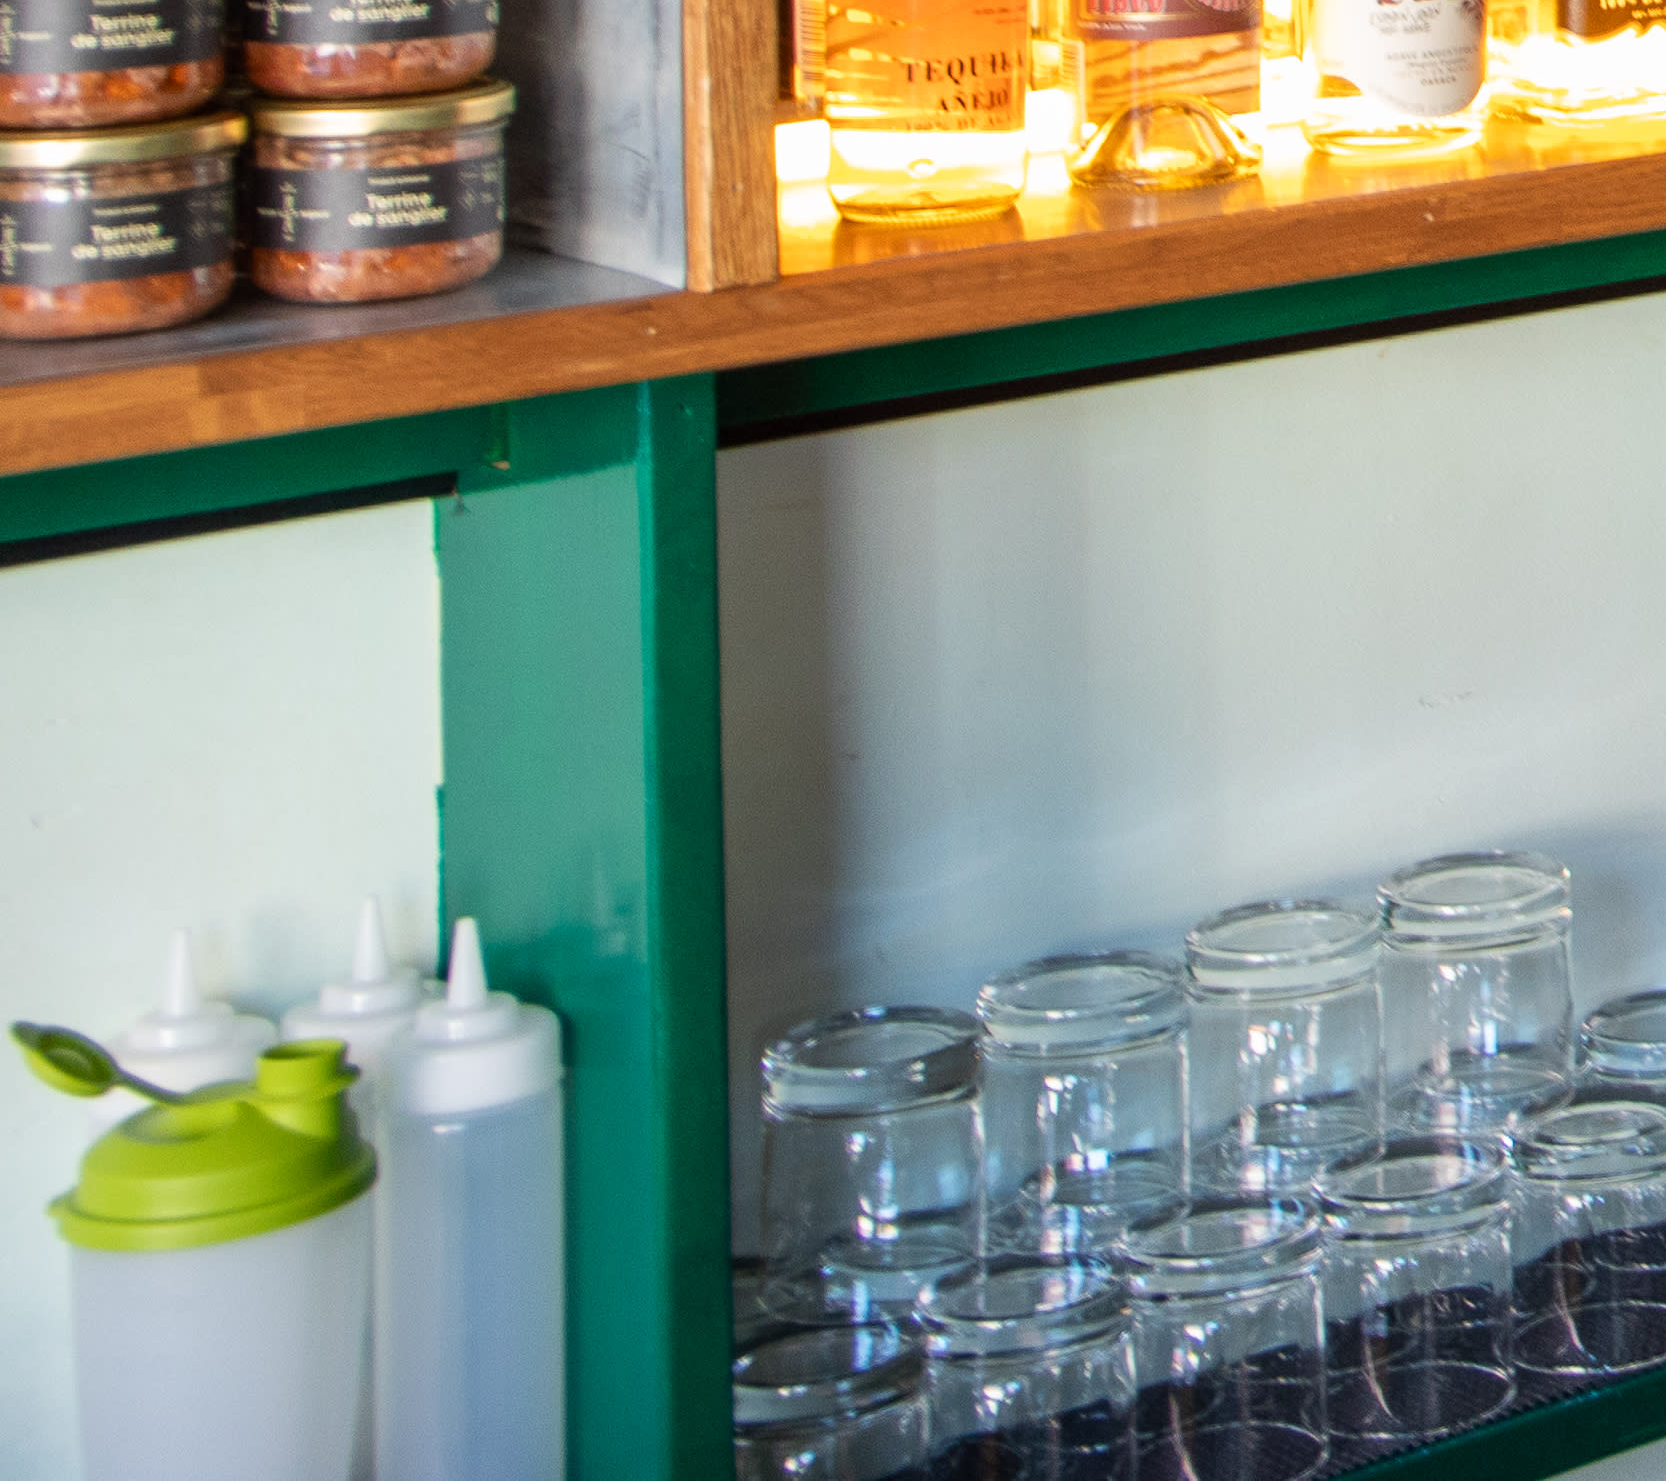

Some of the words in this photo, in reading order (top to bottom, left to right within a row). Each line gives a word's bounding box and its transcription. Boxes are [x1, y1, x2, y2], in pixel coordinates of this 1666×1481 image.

[89, 13, 162, 32] Terrine
[365, 192, 435, 210] Terrine
[91, 221, 163, 241] Terrine
